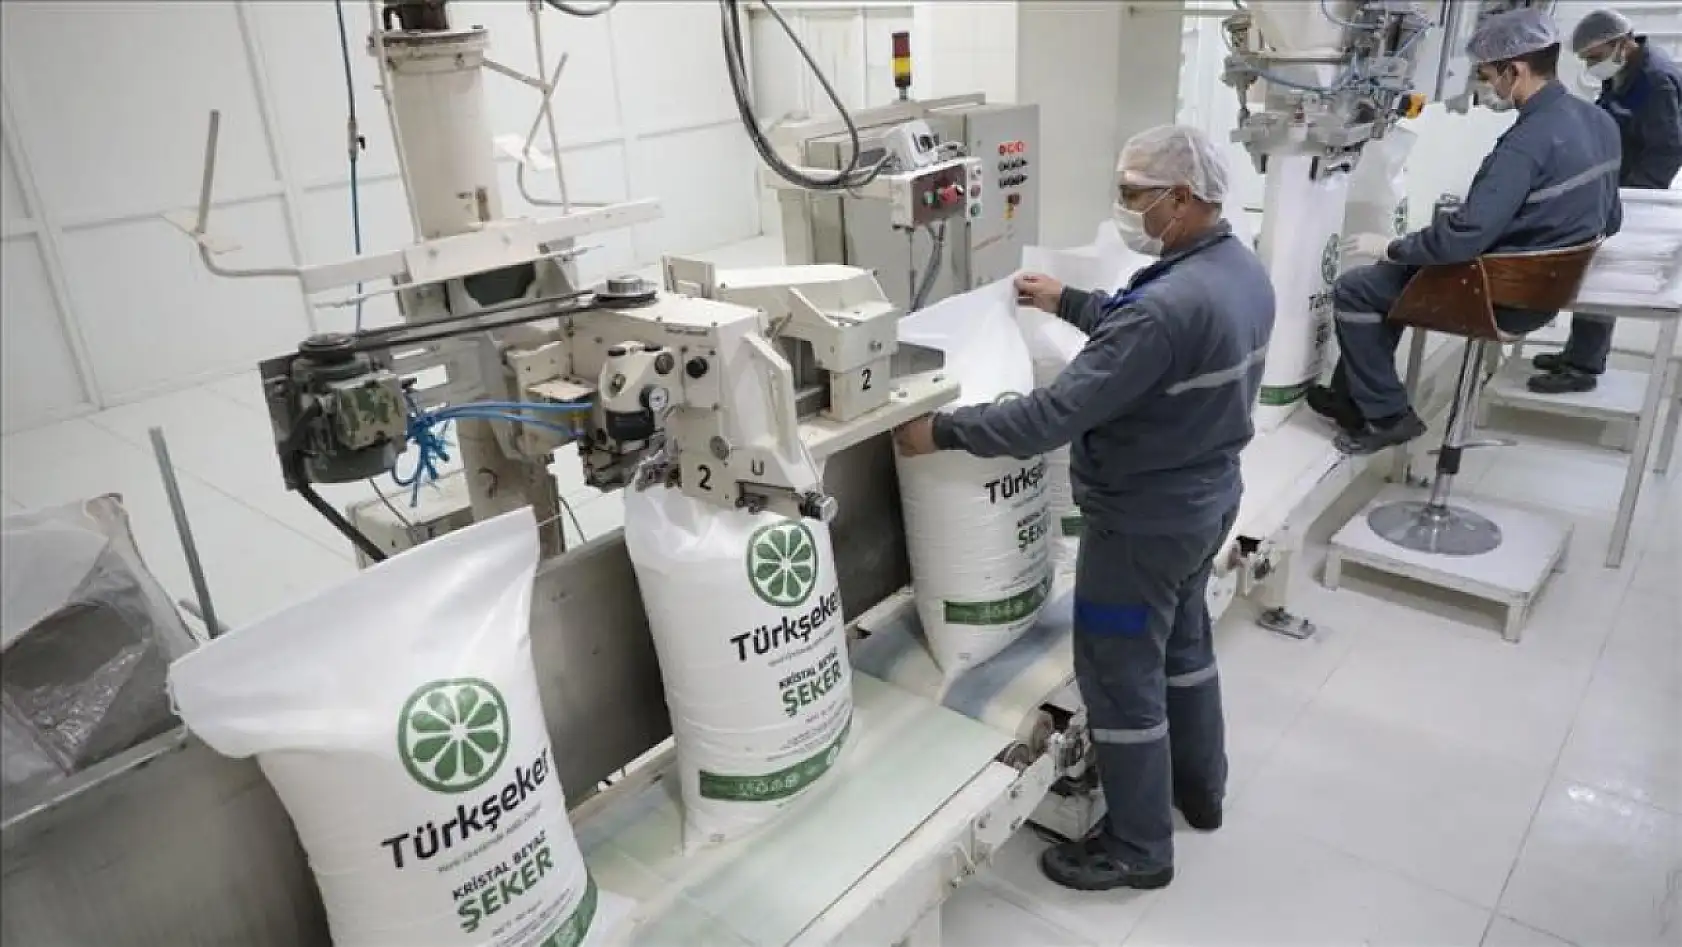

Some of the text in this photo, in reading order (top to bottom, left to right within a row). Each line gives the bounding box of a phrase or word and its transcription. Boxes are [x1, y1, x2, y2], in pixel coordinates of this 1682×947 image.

[861, 369, 872, 390] 2
[698, 464, 711, 490] 2
[730, 588, 839, 661] Türkşeke
[782, 660, 841, 718] ŞEKER
[380, 748, 549, 868] Türkşeker
[452, 861, 511, 900] KRİSTAL
[457, 847, 553, 933] ŞEKER
